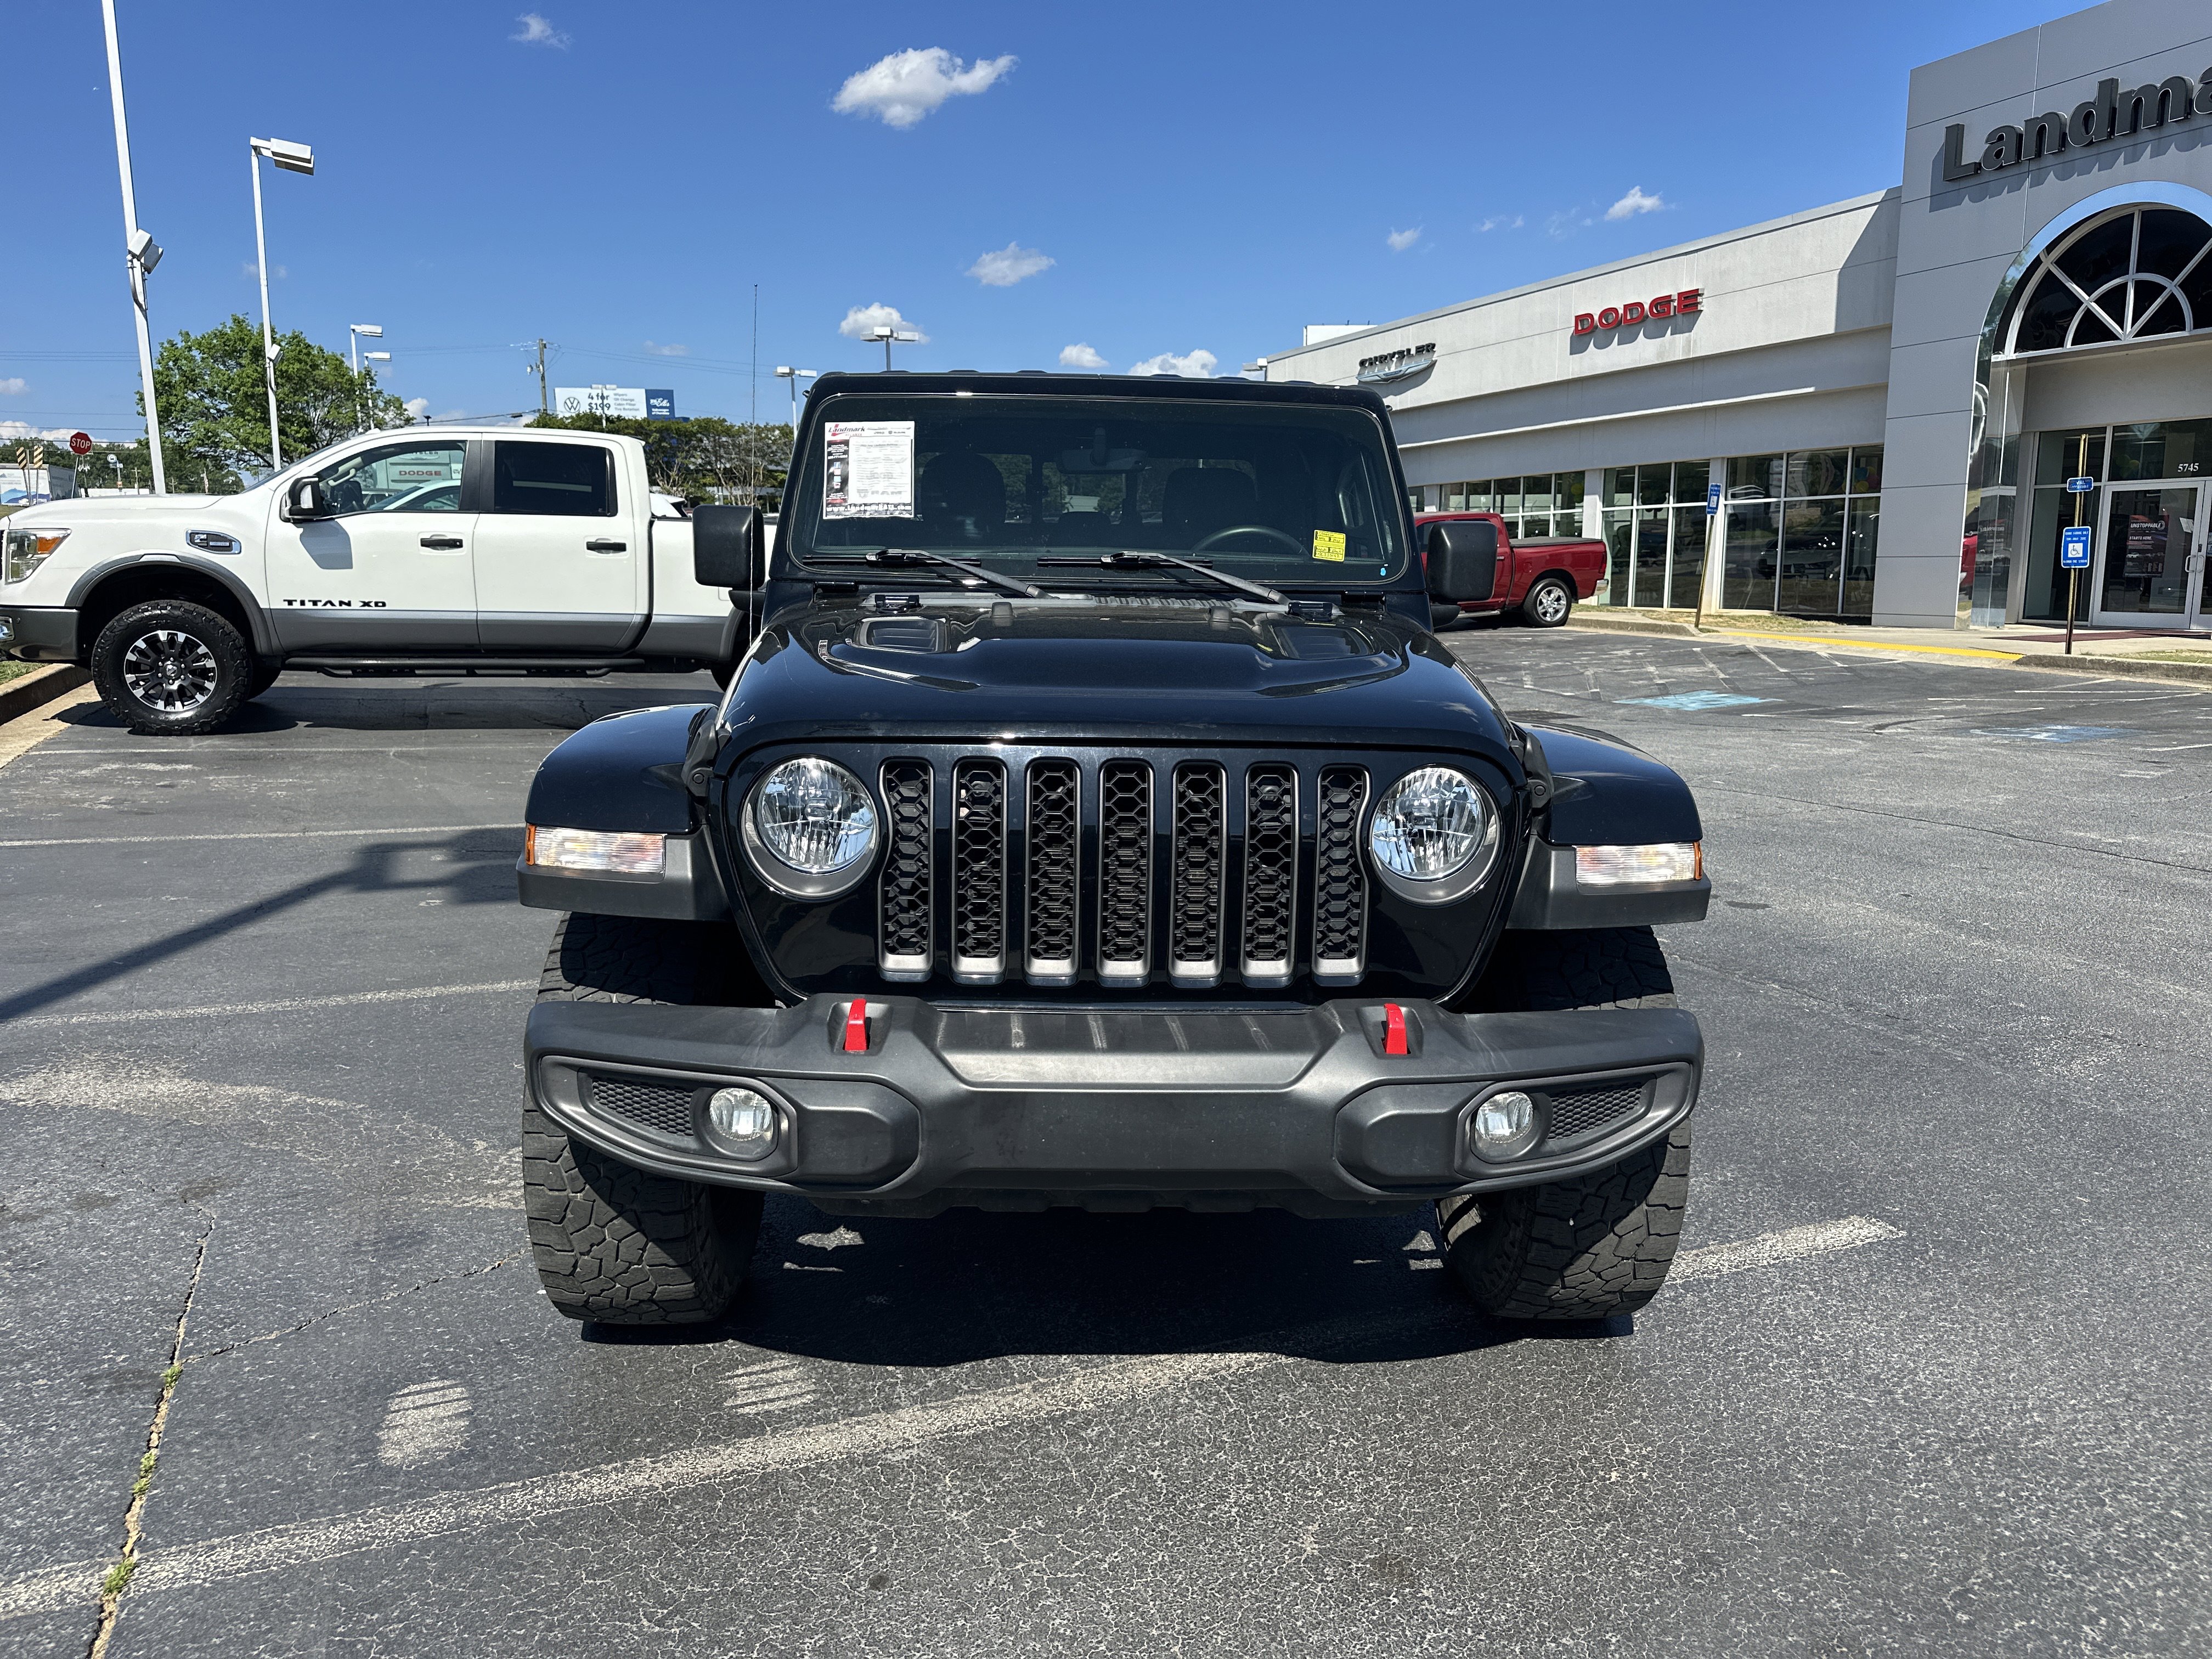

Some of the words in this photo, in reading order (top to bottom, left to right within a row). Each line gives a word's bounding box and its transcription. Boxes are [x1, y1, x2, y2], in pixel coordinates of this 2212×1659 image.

[1573, 288, 1703, 336] DODGE
[1359, 343, 1436, 367] CHRYSLER
[588, 402, 611, 411] $199
[71, 438, 91, 449] STOP
[2177, 463, 2199, 472] 5745
